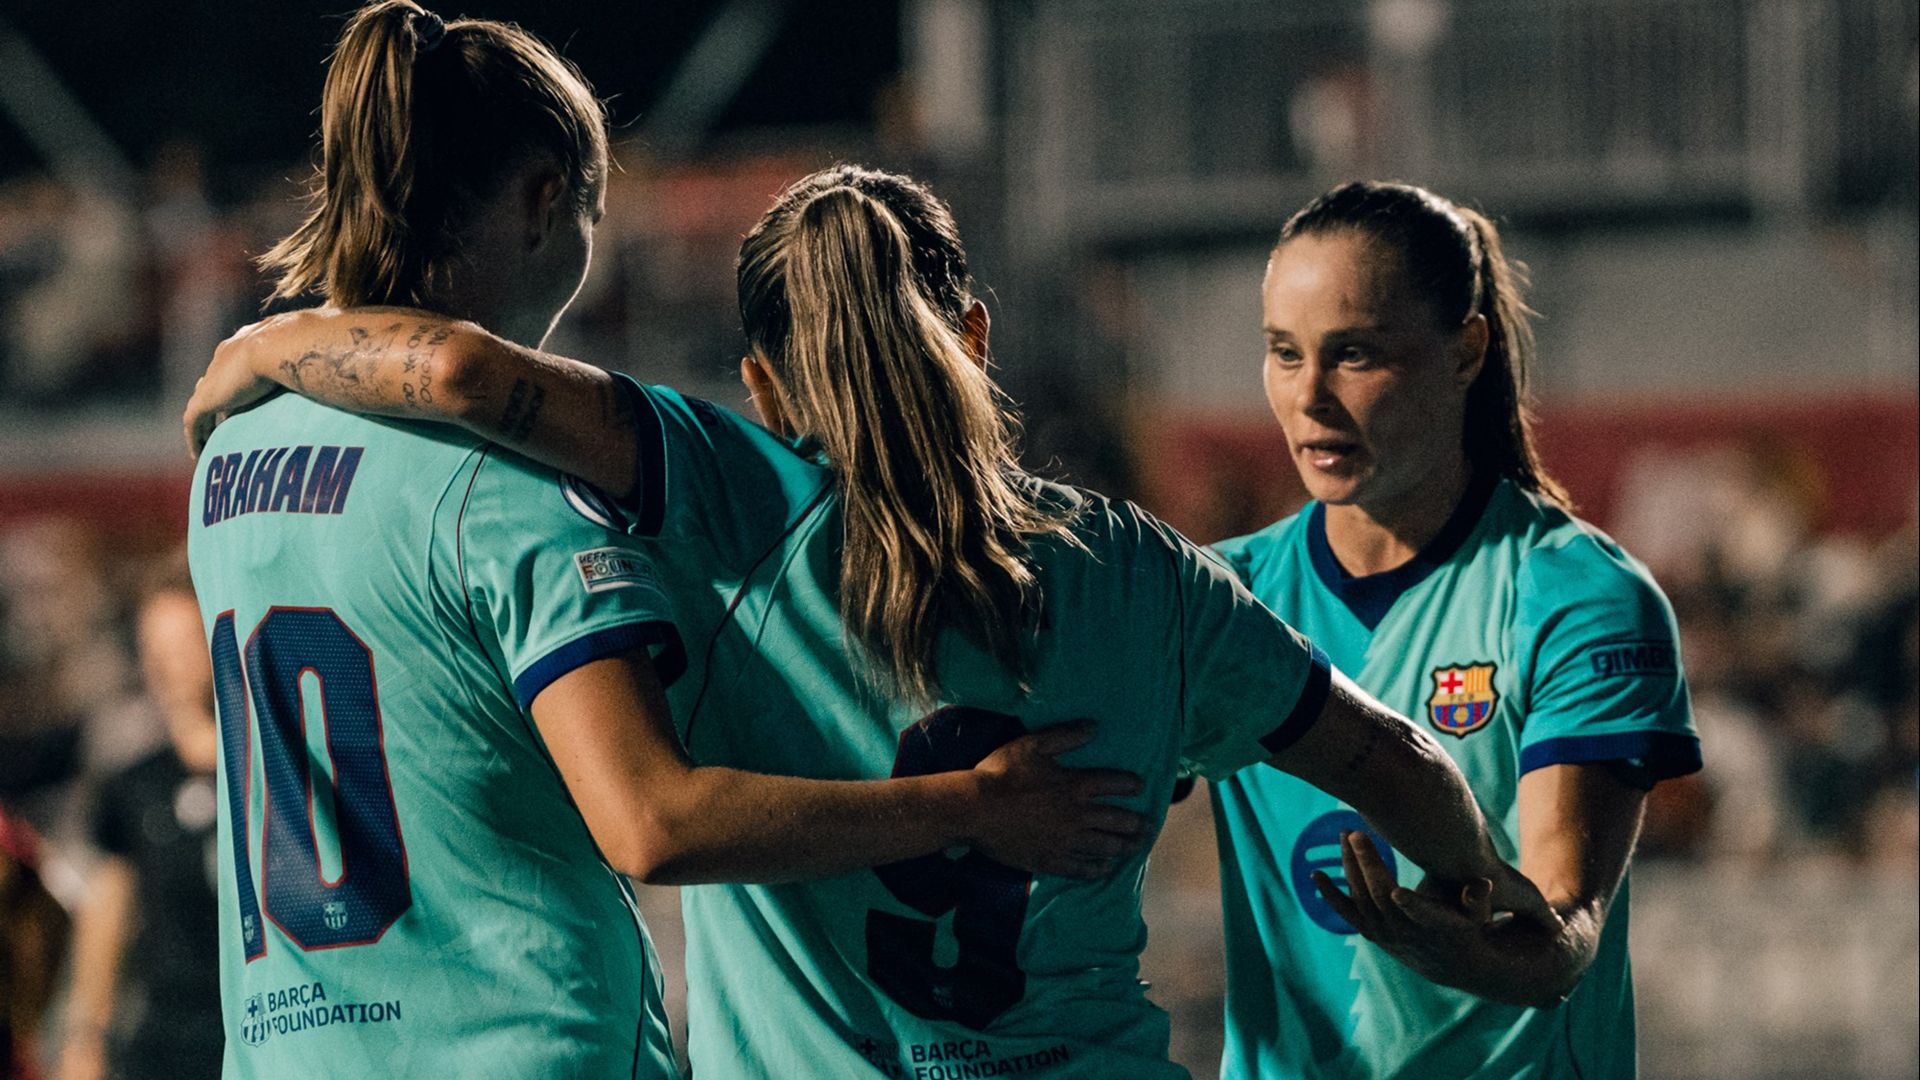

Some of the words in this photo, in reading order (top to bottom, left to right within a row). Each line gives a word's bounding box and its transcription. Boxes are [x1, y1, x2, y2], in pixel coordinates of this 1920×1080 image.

[202, 445, 365, 528] GRAHAM
[210, 605, 412, 965] 10
[865, 704, 1034, 1032] 9
[268, 982, 326, 1012] BARÇA
[272, 1000, 401, 1035] FOUNDATION
[910, 1039, 991, 1062] BARÇA
[915, 1043, 1072, 1080] FOUNDATION
